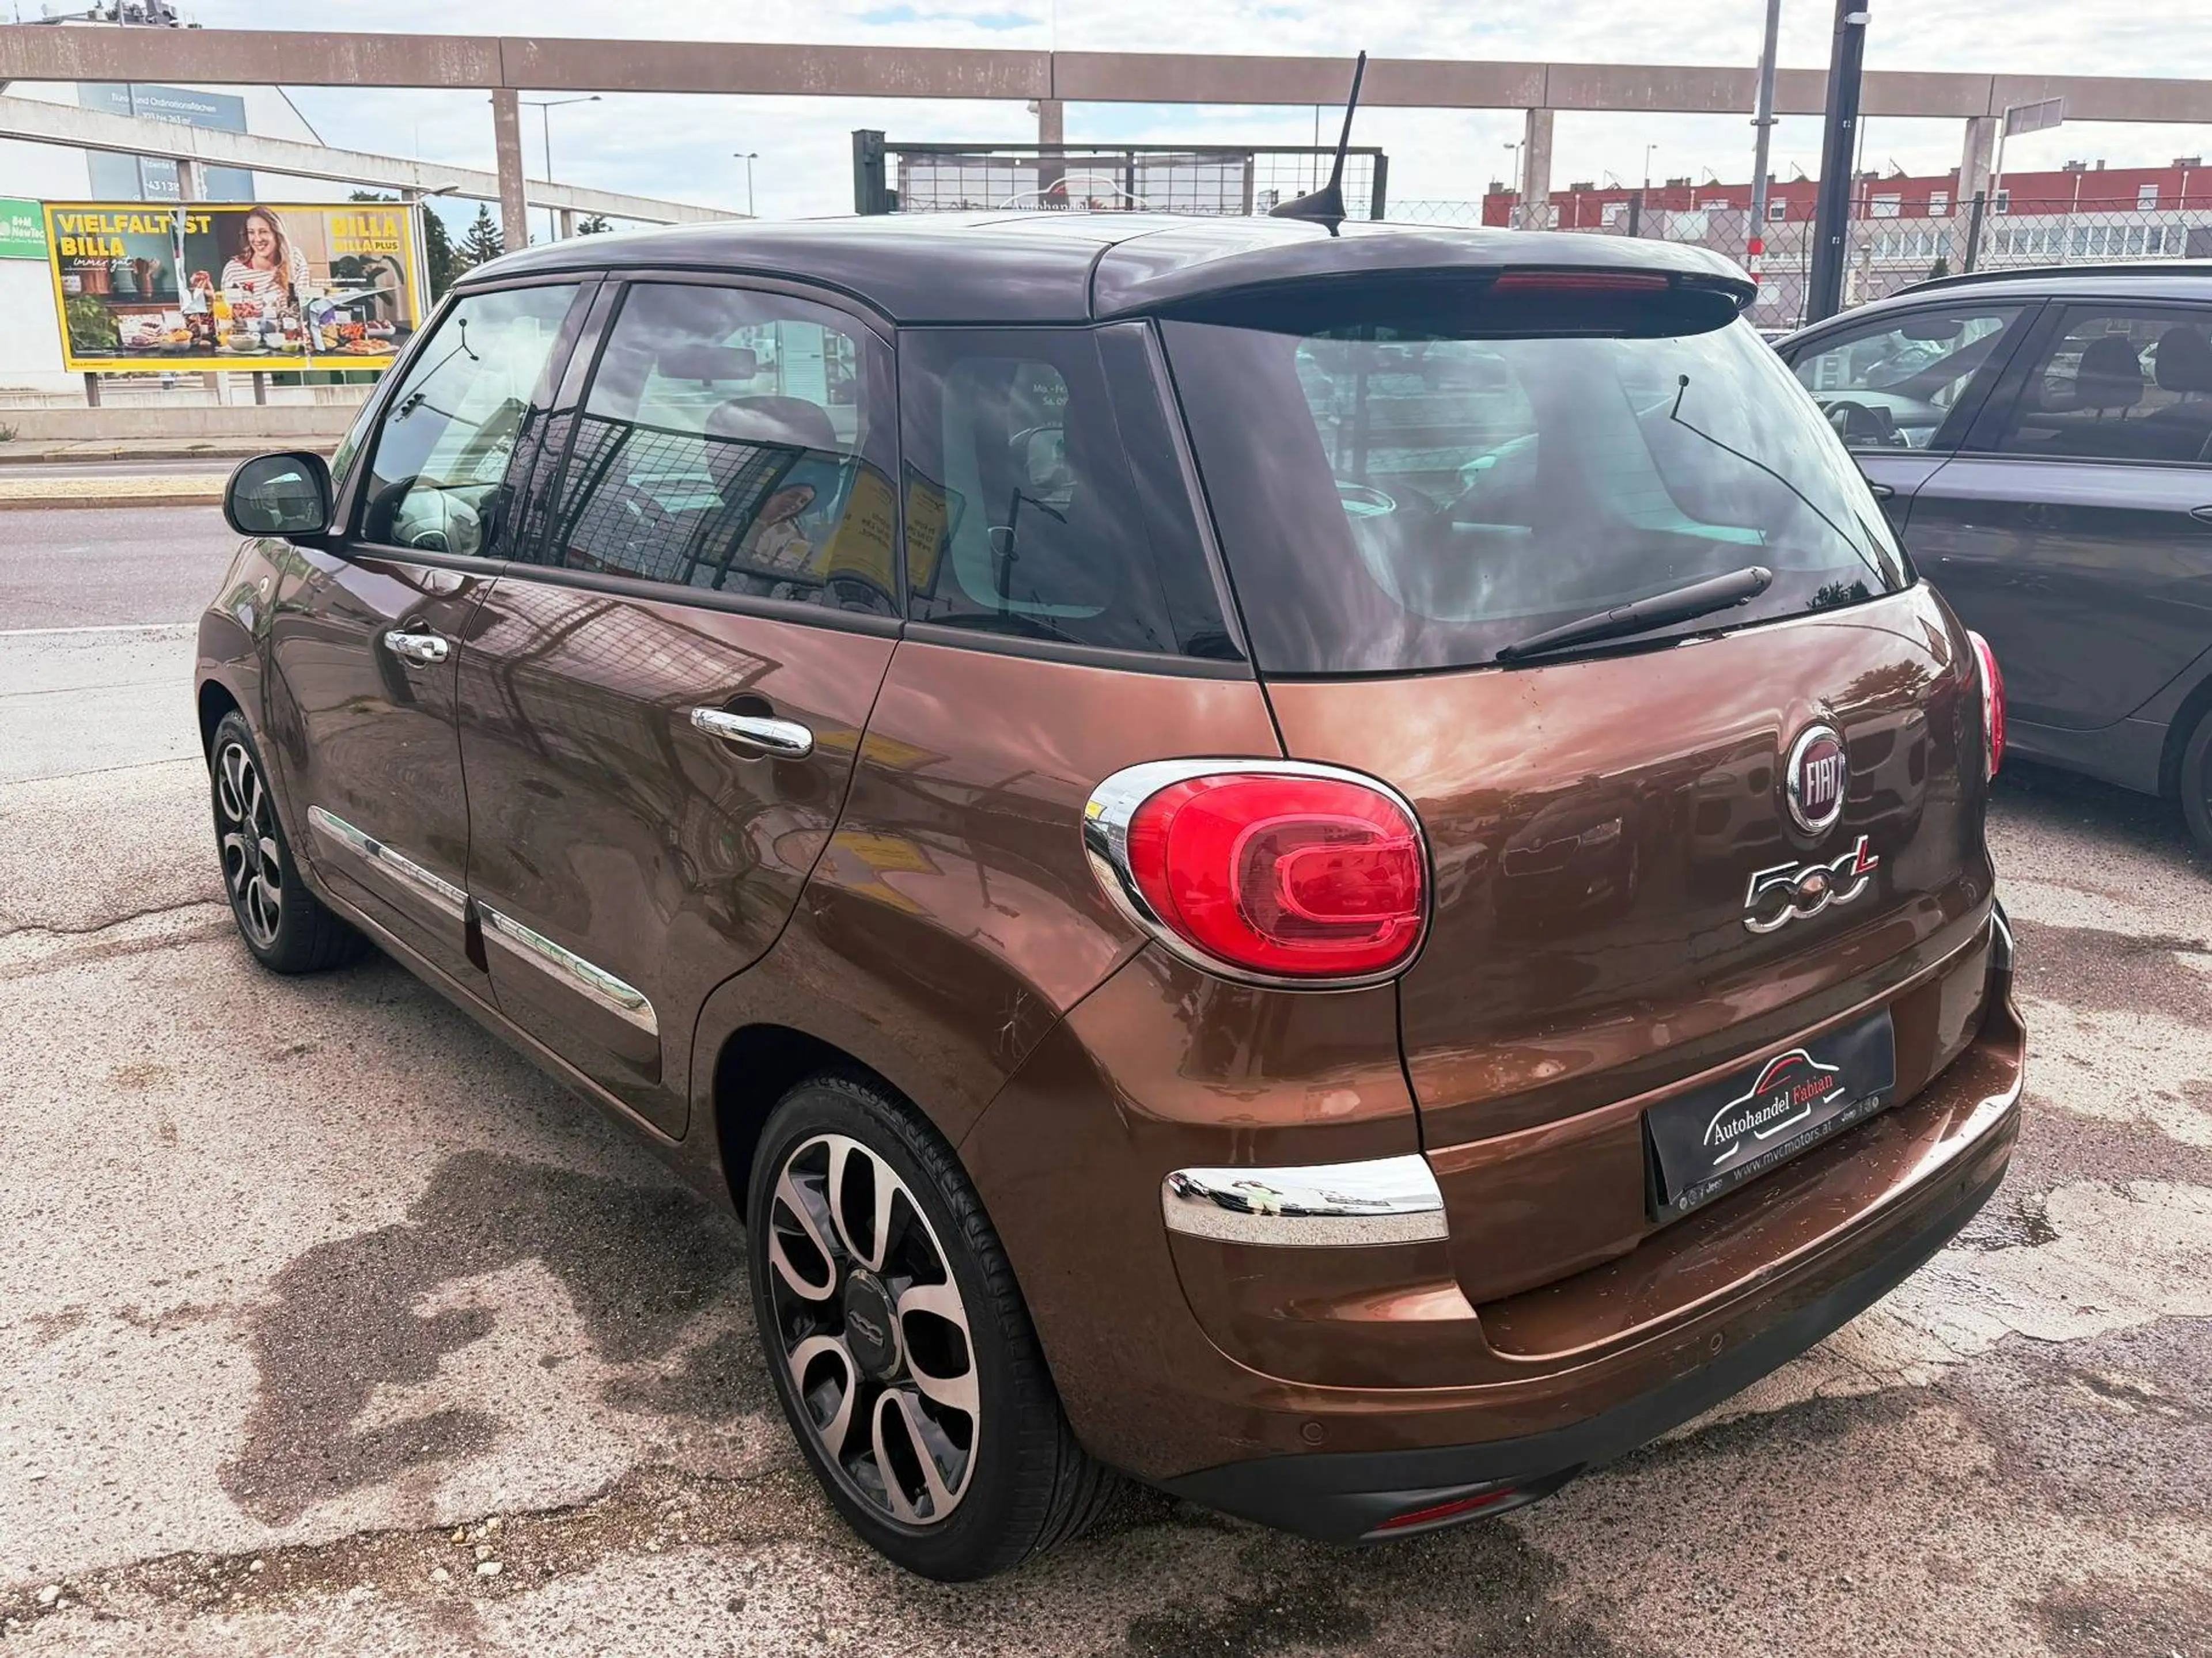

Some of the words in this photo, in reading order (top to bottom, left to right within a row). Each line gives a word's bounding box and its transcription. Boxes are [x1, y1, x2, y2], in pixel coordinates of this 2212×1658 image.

[57, 214, 168, 233] VIELFALT
[331, 215, 398, 237] BILLA
[60, 237, 126, 256] BILLA
[332, 240, 372, 253] BILLA
[1806, 755, 1838, 806] FIAT
[1714, 1091, 1789, 1145] Autohandel
[1793, 1074, 1833, 1105] Fabian
[1733, 1120, 1833, 1181] www.mvcmotors.at
